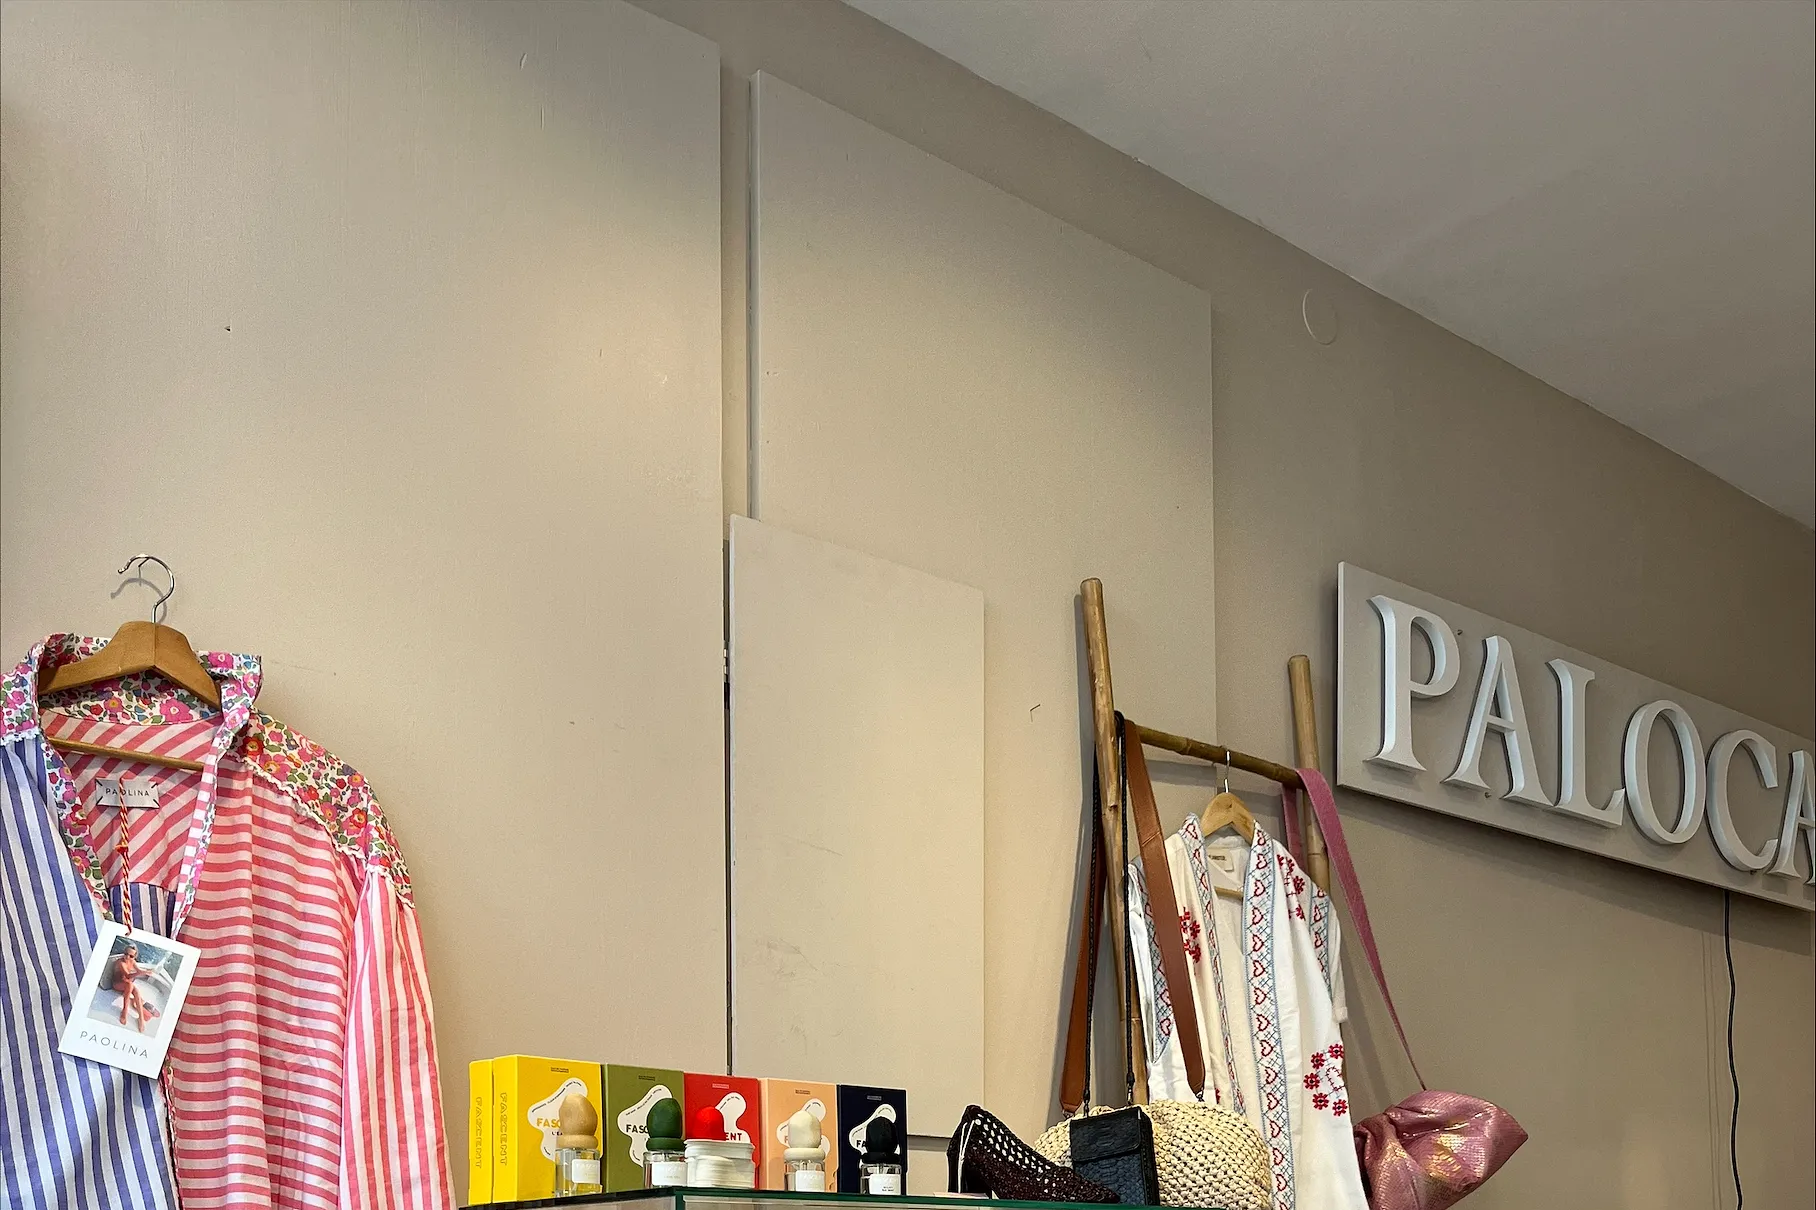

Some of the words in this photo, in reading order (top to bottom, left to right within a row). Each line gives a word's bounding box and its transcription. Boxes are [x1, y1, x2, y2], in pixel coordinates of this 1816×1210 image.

[1362, 595, 1815, 885] PALOCA
[79, 1031, 149, 1059] PAOLINA
[536, 1117, 561, 1128] FASC
[626, 1124, 649, 1134] FASC
